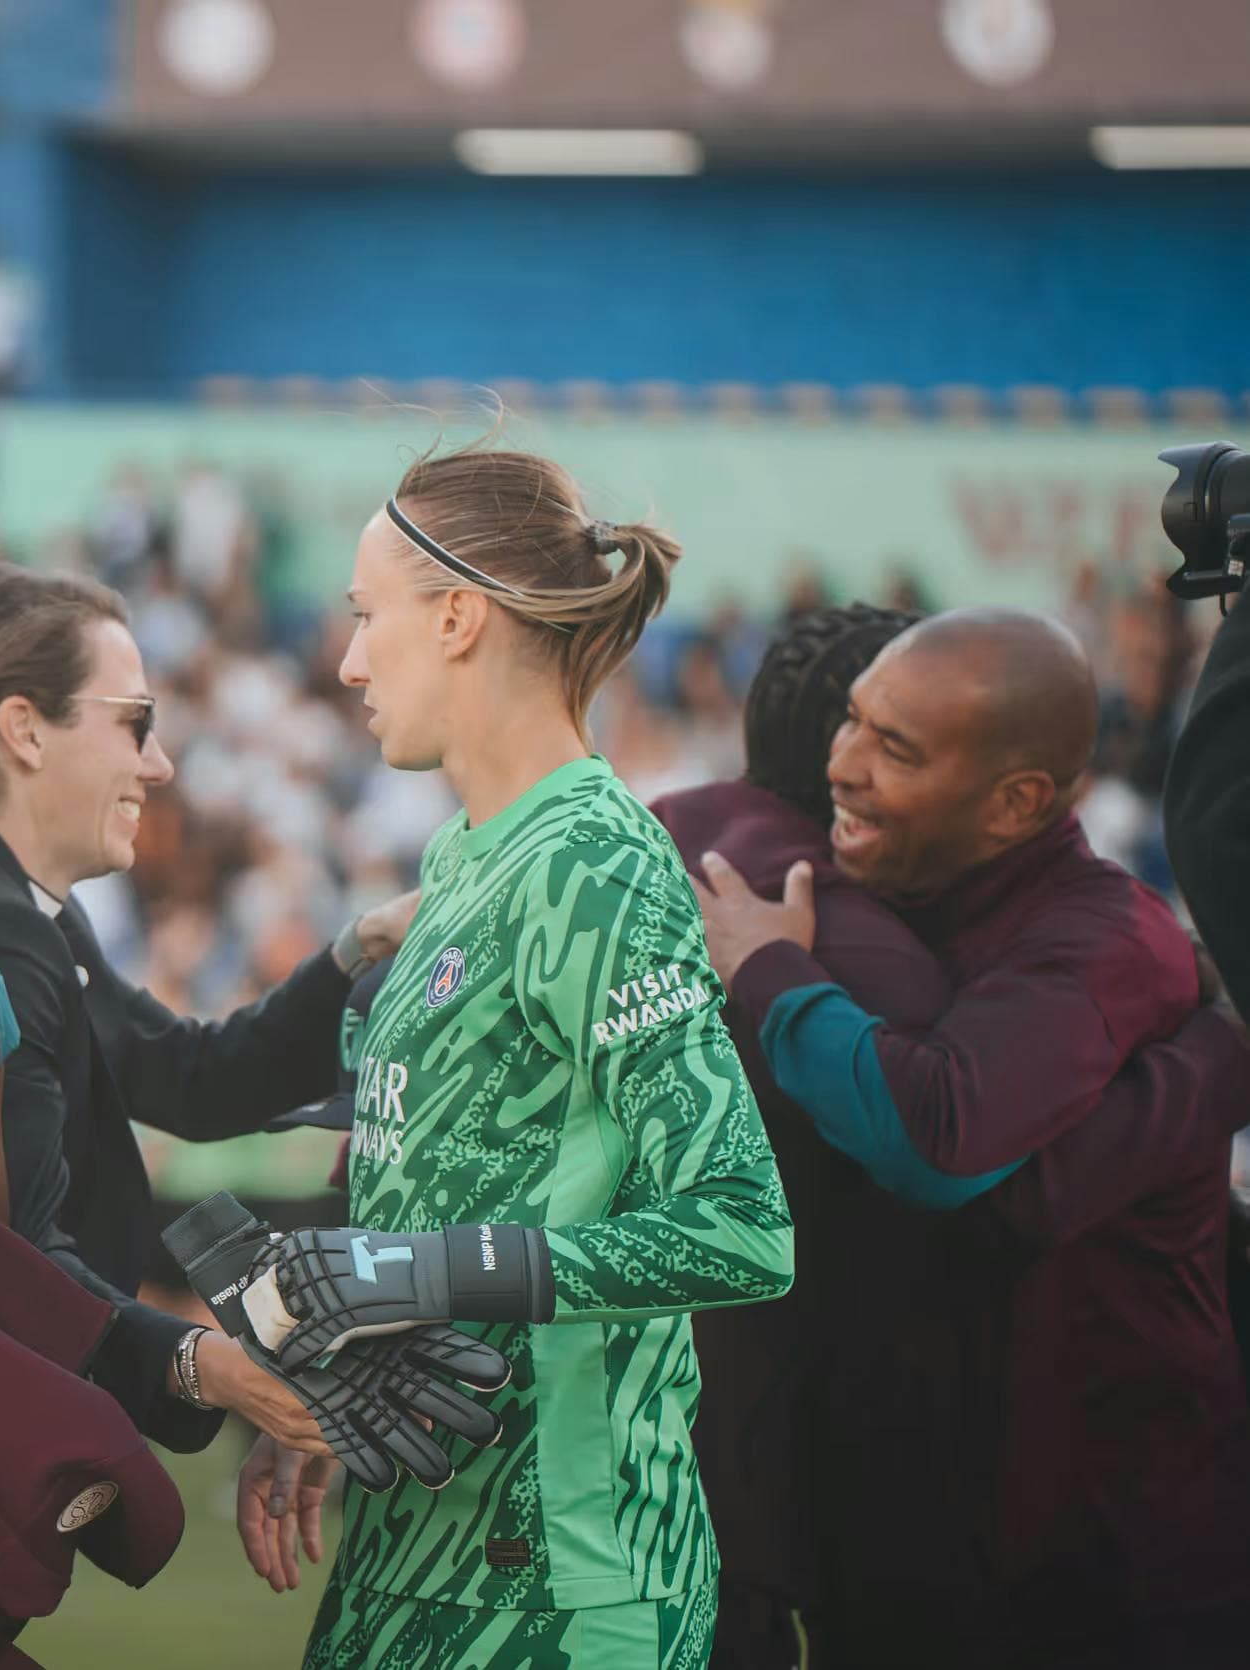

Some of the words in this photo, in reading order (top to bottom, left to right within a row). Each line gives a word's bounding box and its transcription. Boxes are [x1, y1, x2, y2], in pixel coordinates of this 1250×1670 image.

[607, 963, 682, 1008] VISIT
[592, 981, 711, 1046] RWANDA
[360, 1056, 409, 1123] TAR
[481, 1242, 496, 1271] NSNP
[210, 1283, 240, 1305] Kasia
